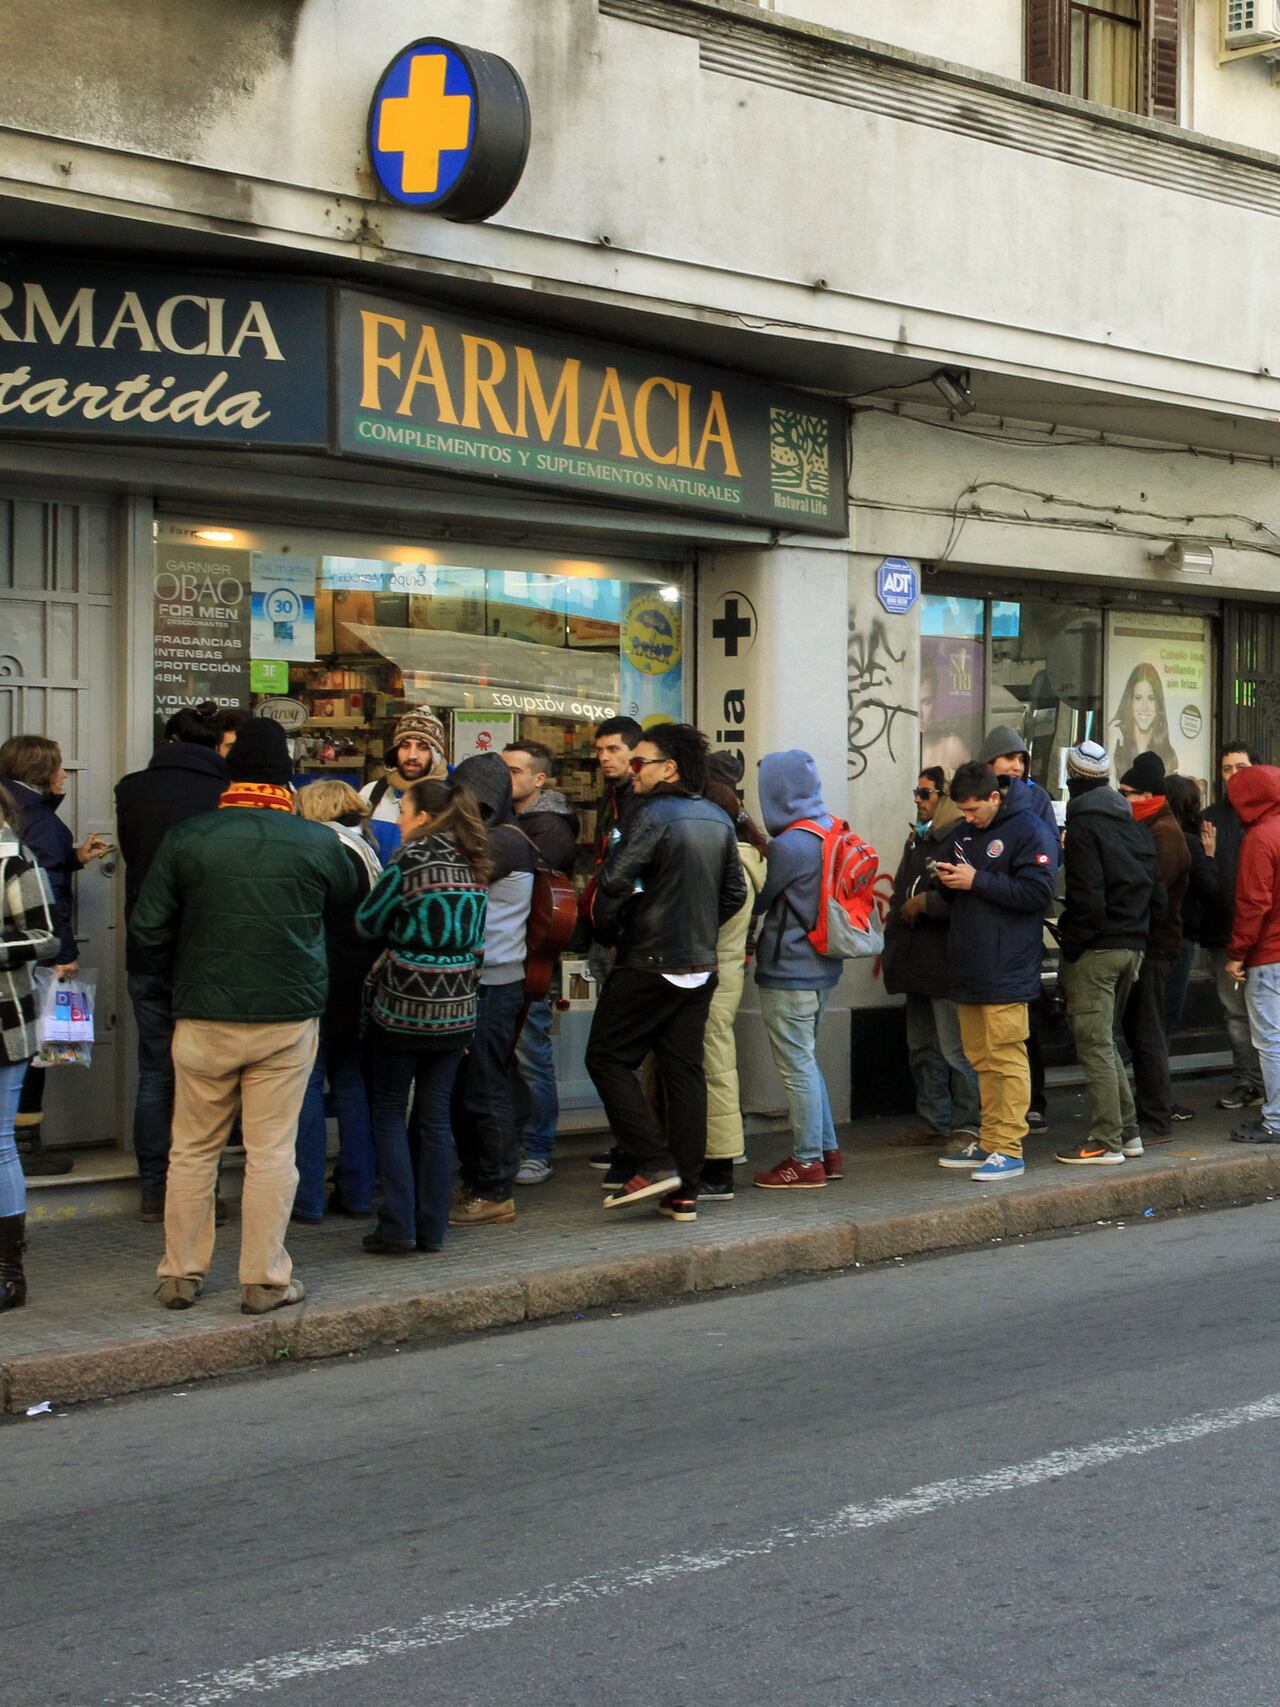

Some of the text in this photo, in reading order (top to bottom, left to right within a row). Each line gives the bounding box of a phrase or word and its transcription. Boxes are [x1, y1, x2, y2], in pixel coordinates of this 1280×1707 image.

[360, 310, 742, 477] FARMACIA
[358, 421, 742, 504] COMPLEMENTOS Y SUPLEMENTOS NATURALES
[774, 492, 828, 516] Natural Life
[154, 573, 243, 605] OBAO
[883, 572, 912, 594] ADT
[159, 604, 238, 620] FOR MEN
[274, 599, 292, 613] 30
[155, 635, 242, 648] FRAGANCIAS
[155, 648, 223, 659] INTENSAS
[155, 661, 241, 673] PROTECCIÓN
